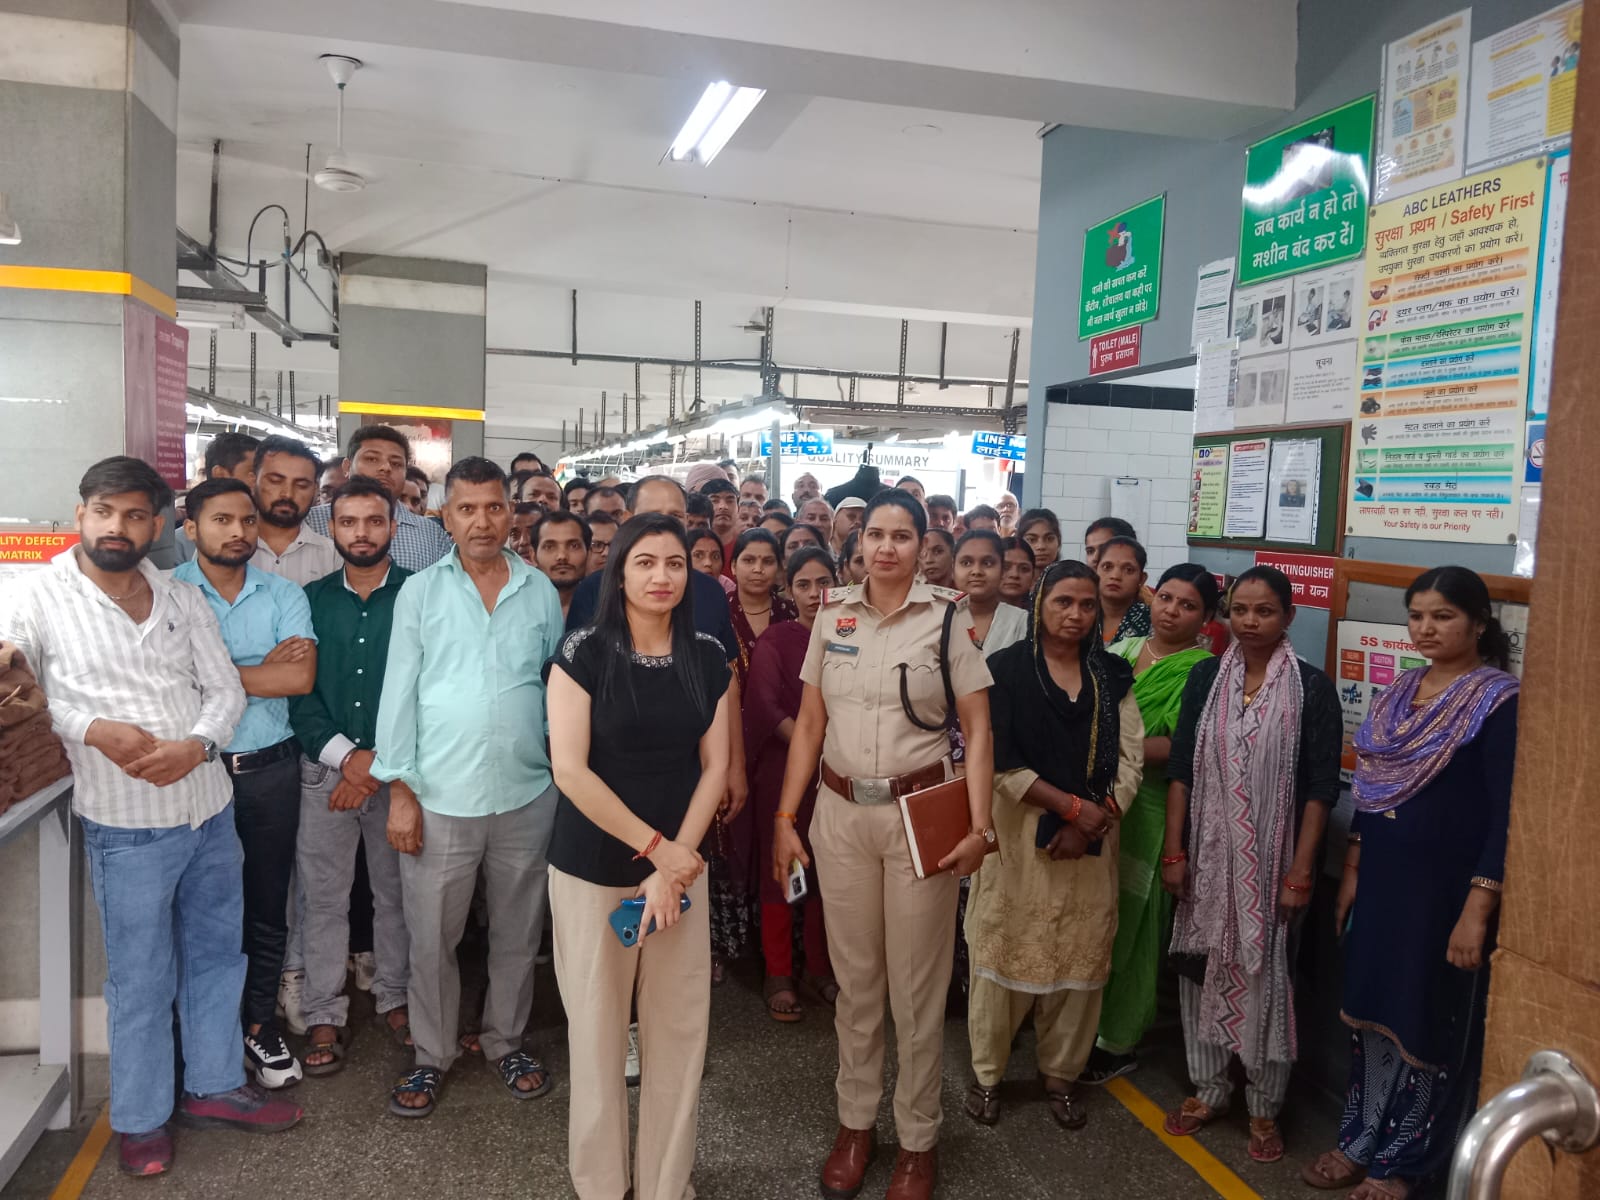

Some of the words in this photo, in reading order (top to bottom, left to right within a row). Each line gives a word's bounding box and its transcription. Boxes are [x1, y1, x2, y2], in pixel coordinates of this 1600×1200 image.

[1403, 199, 1428, 217] ABC
[1432, 178, 1501, 209] LEATHERS
[1254, 217, 1275, 237] जब
[1278, 198, 1305, 229] कार्य
[1308, 202, 1320, 220] न
[1323, 191, 1338, 220] हो
[1342, 184, 1359, 212] तो
[1375, 225, 1404, 251] सुरक्षा
[1409, 216, 1436, 236] प्रथम
[1451, 204, 1495, 225] Safety
[1500, 191, 1535, 213] First
[1252, 241, 1289, 268] मशीन
[1292, 235, 1311, 257] बंद
[1314, 231, 1336, 252] कर
[1464, 244, 1475, 253] का
[1099, 338, 1118, 351] TOILET
[1118, 333, 1137, 348] (MALE)
[765, 433, 795, 443] LNE
[976, 432, 1006, 446] LINE
[808, 452, 863, 464] QUALITY
[869, 453, 929, 467] SUMMARY
[1383, 520, 1398, 529] Your
[1399, 520, 1420, 531] Safety
[1443, 521, 1470, 533] Priority
[0, 535, 22, 546] LITY
[25, 536, 66, 546] DEFECT
[0, 550, 42, 560] MATRIX
[1275, 563, 1334, 579] EXTINGUISHER
[1360, 635, 1378, 647] 5S
